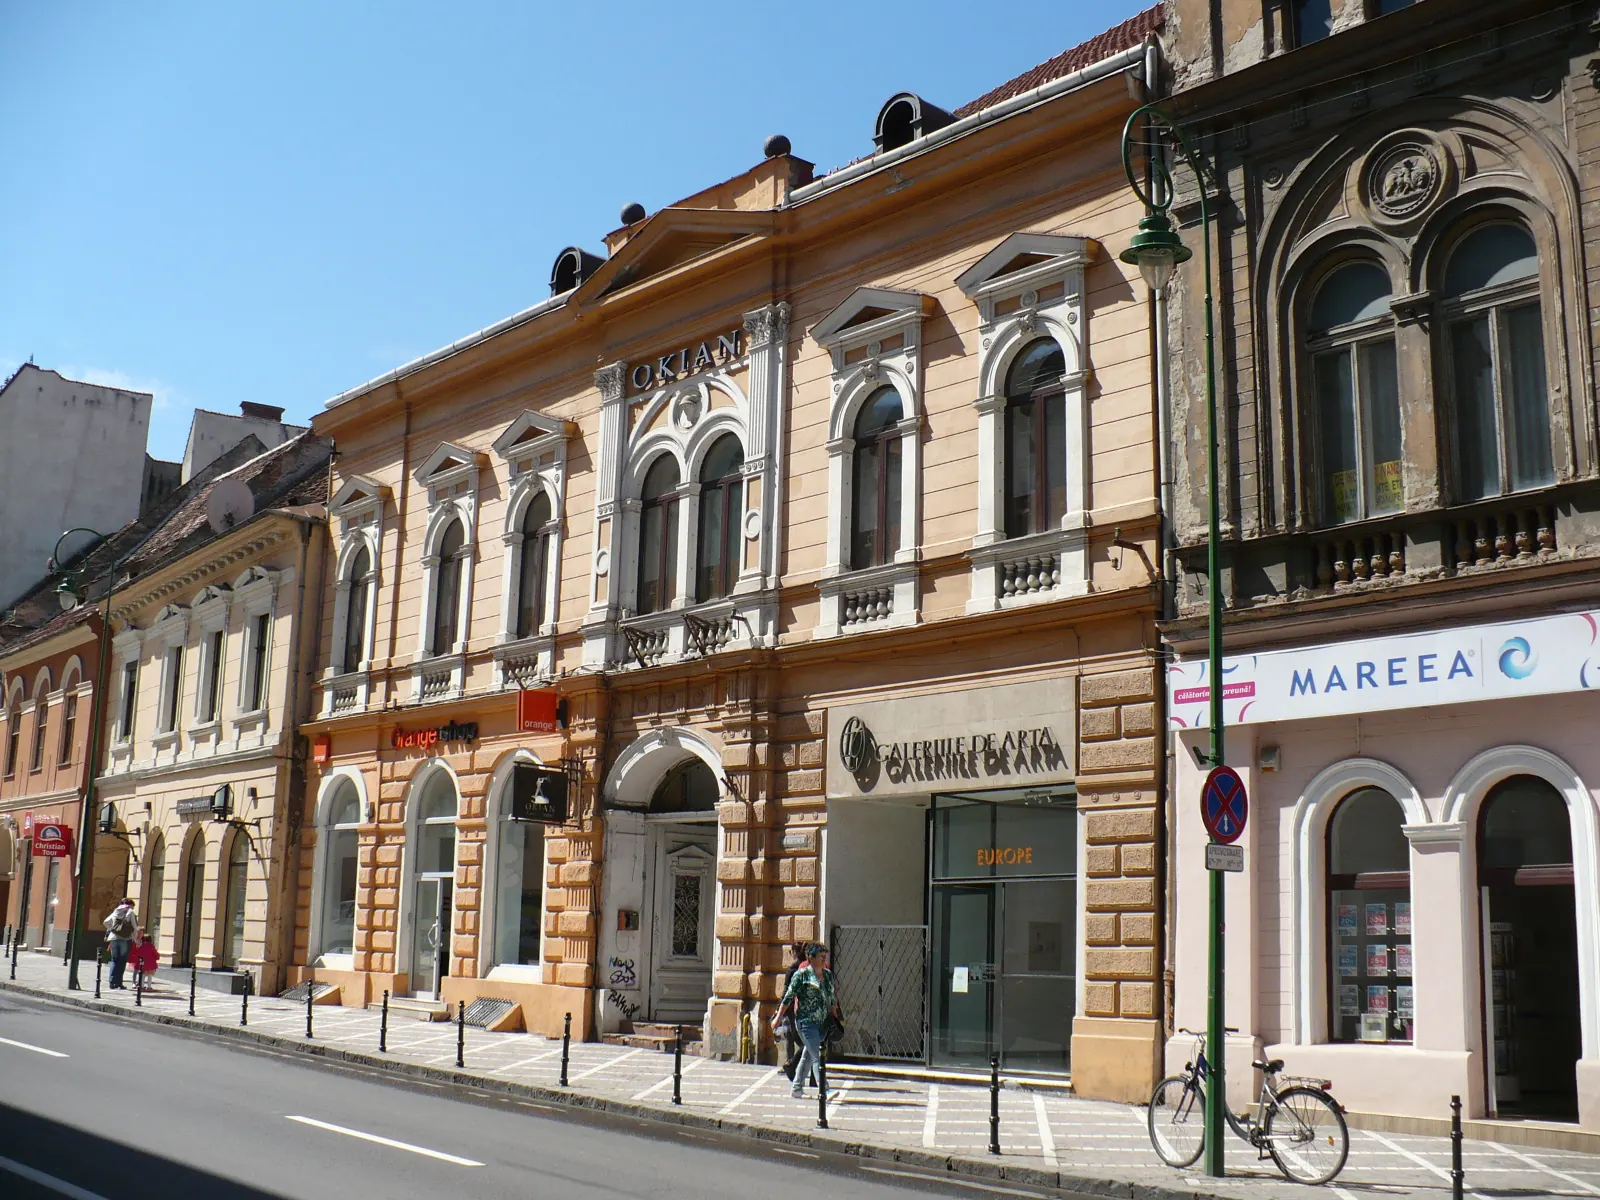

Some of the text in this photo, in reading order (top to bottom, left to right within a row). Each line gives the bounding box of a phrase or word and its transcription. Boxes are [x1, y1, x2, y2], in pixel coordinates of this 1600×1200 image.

[632, 329, 740, 389] OKIAN
[1289, 650, 1474, 697] MAREEA
[524, 720, 553, 731] orange
[971, 733, 997, 754] DE
[1002, 726, 1055, 751] ARTA
[35, 842, 66, 850] Christian
[976, 846, 1033, 866] EUROPE
